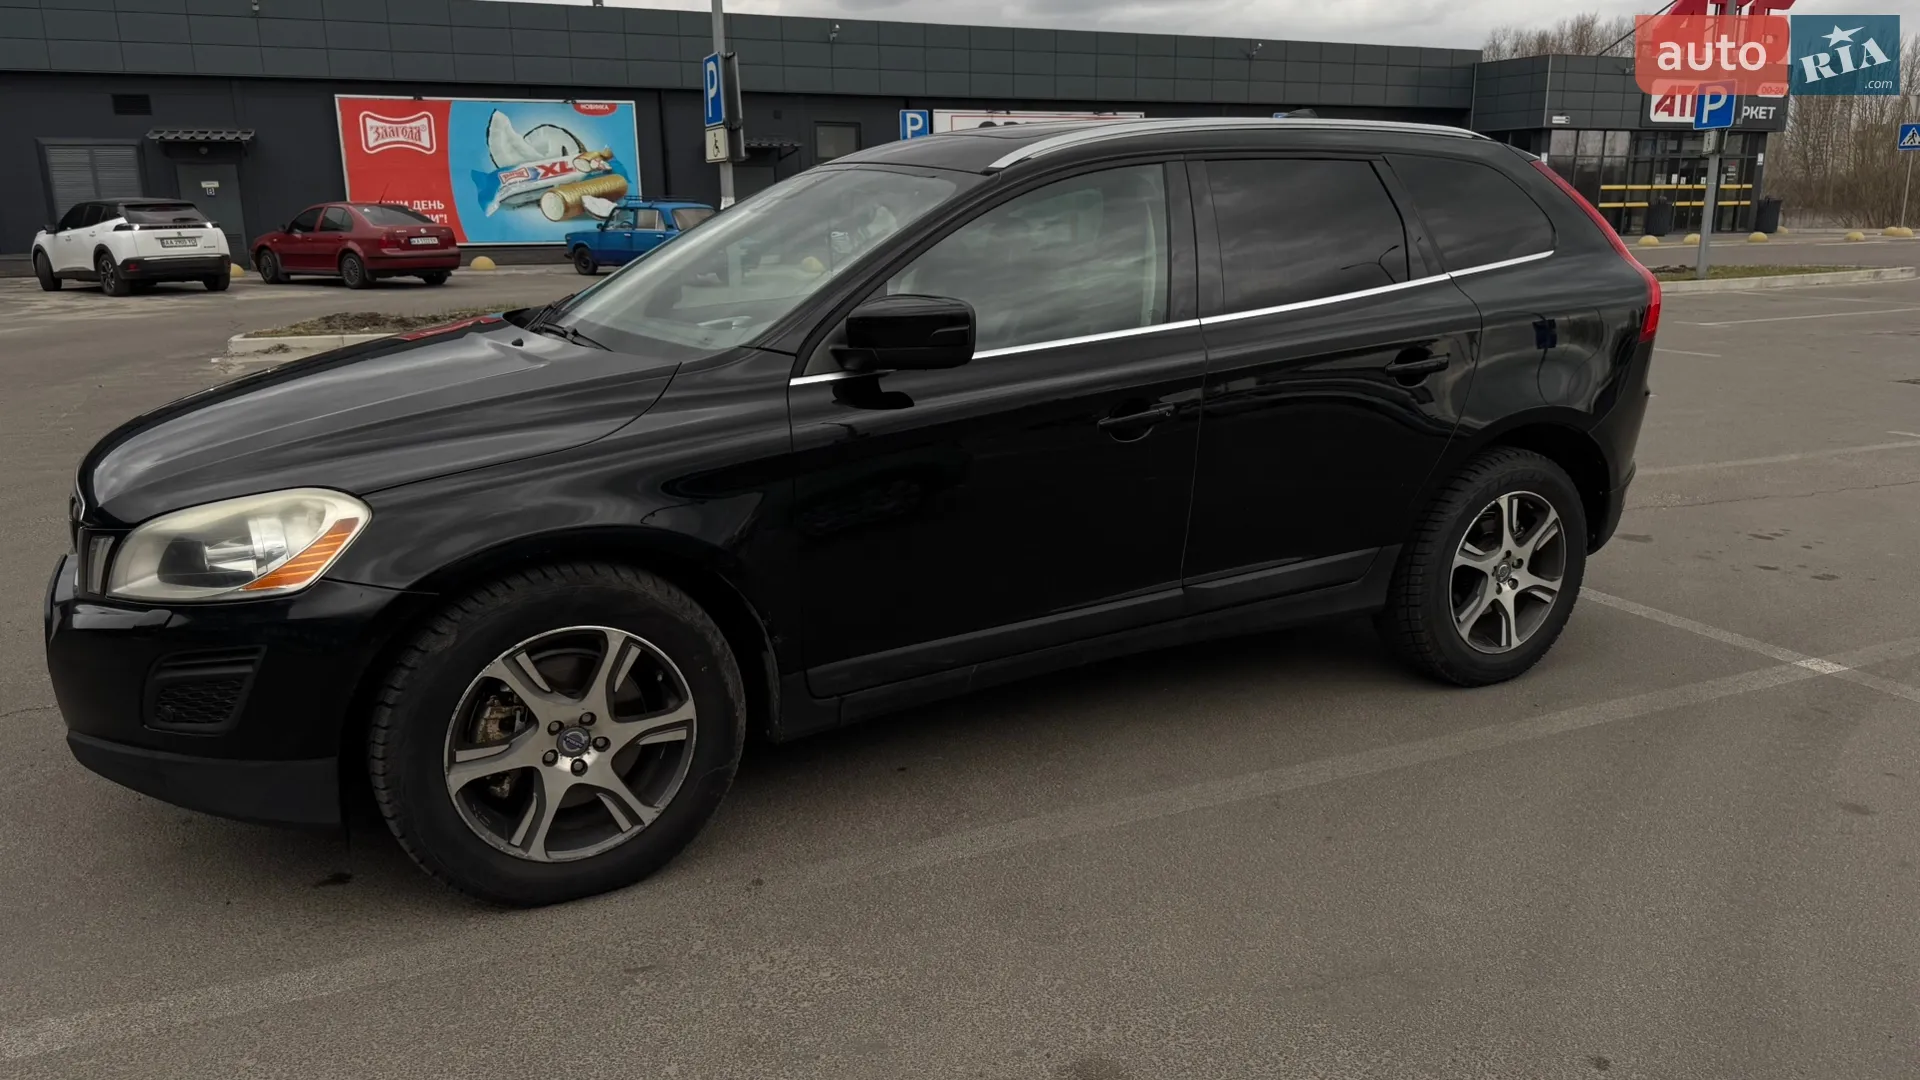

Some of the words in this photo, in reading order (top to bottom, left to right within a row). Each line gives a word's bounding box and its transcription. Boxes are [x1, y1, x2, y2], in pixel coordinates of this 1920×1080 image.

[706, 60, 718, 118] P
[1761, 86, 1785, 95] 00-24
[1702, 86, 1728, 124] P
[1743, 106, 1776, 119] РКЕТ
[906, 113, 923, 139] P
[537, 161, 573, 180] XL
[413, 200, 445, 211] ДЕНЬ
